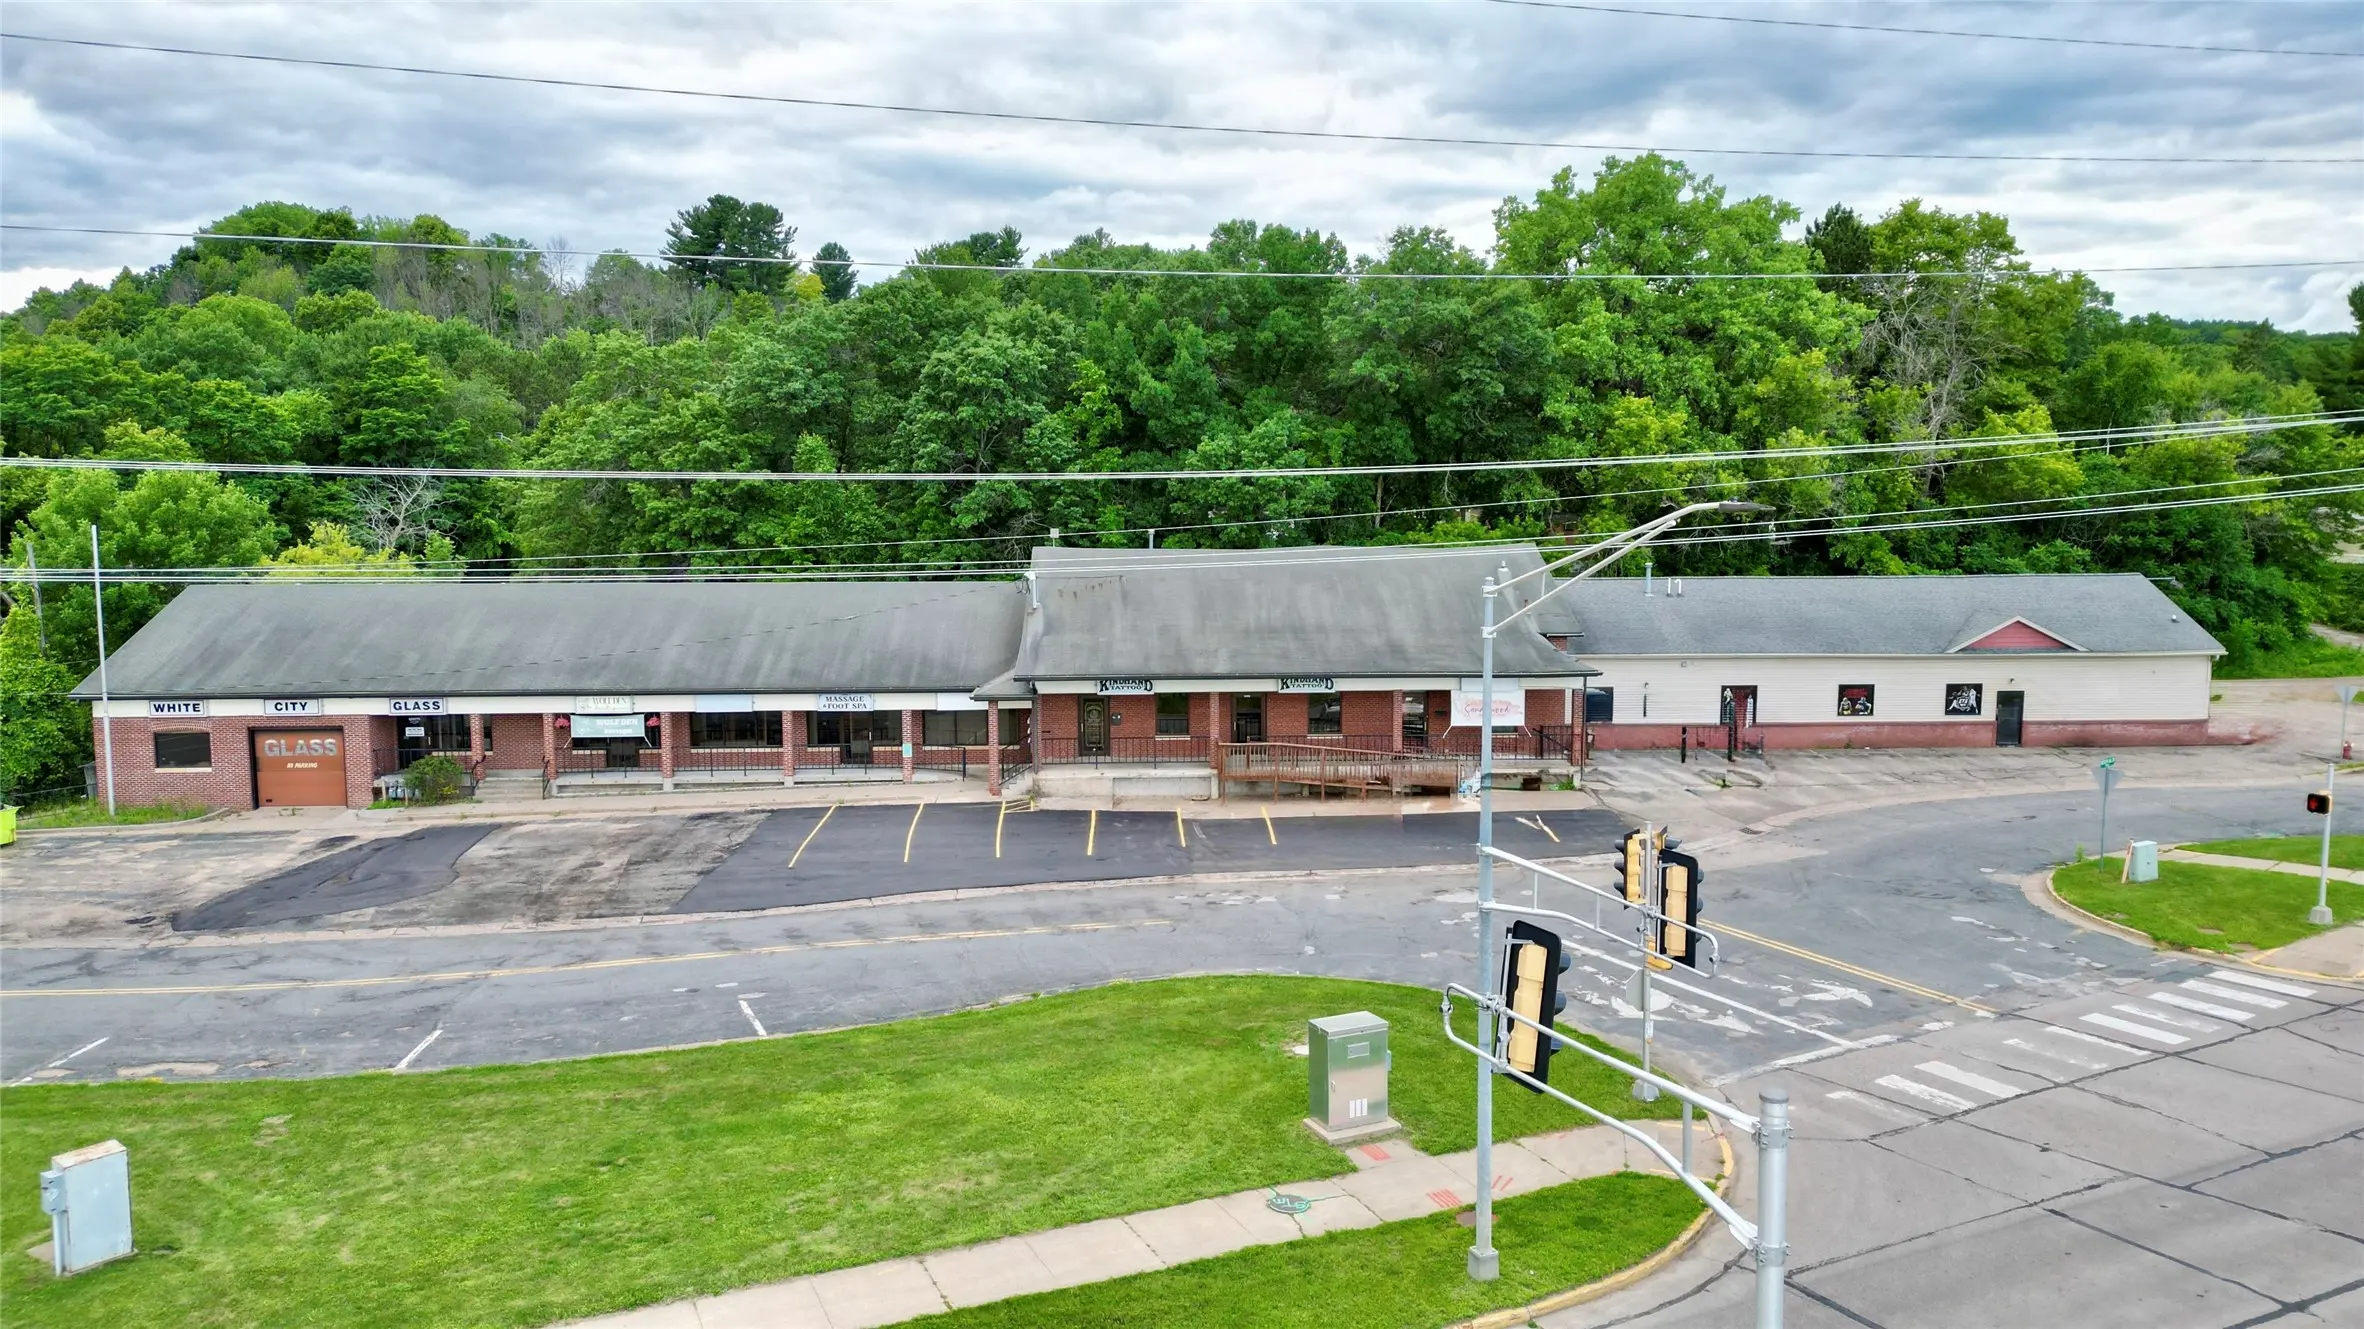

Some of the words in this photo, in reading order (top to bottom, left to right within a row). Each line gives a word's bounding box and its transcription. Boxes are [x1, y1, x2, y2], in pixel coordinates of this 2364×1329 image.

[153, 703, 201, 712] WHITE
[274, 702, 308, 711] CITY
[393, 701, 440, 711] GLASS
[264, 738, 337, 756] GLASS
